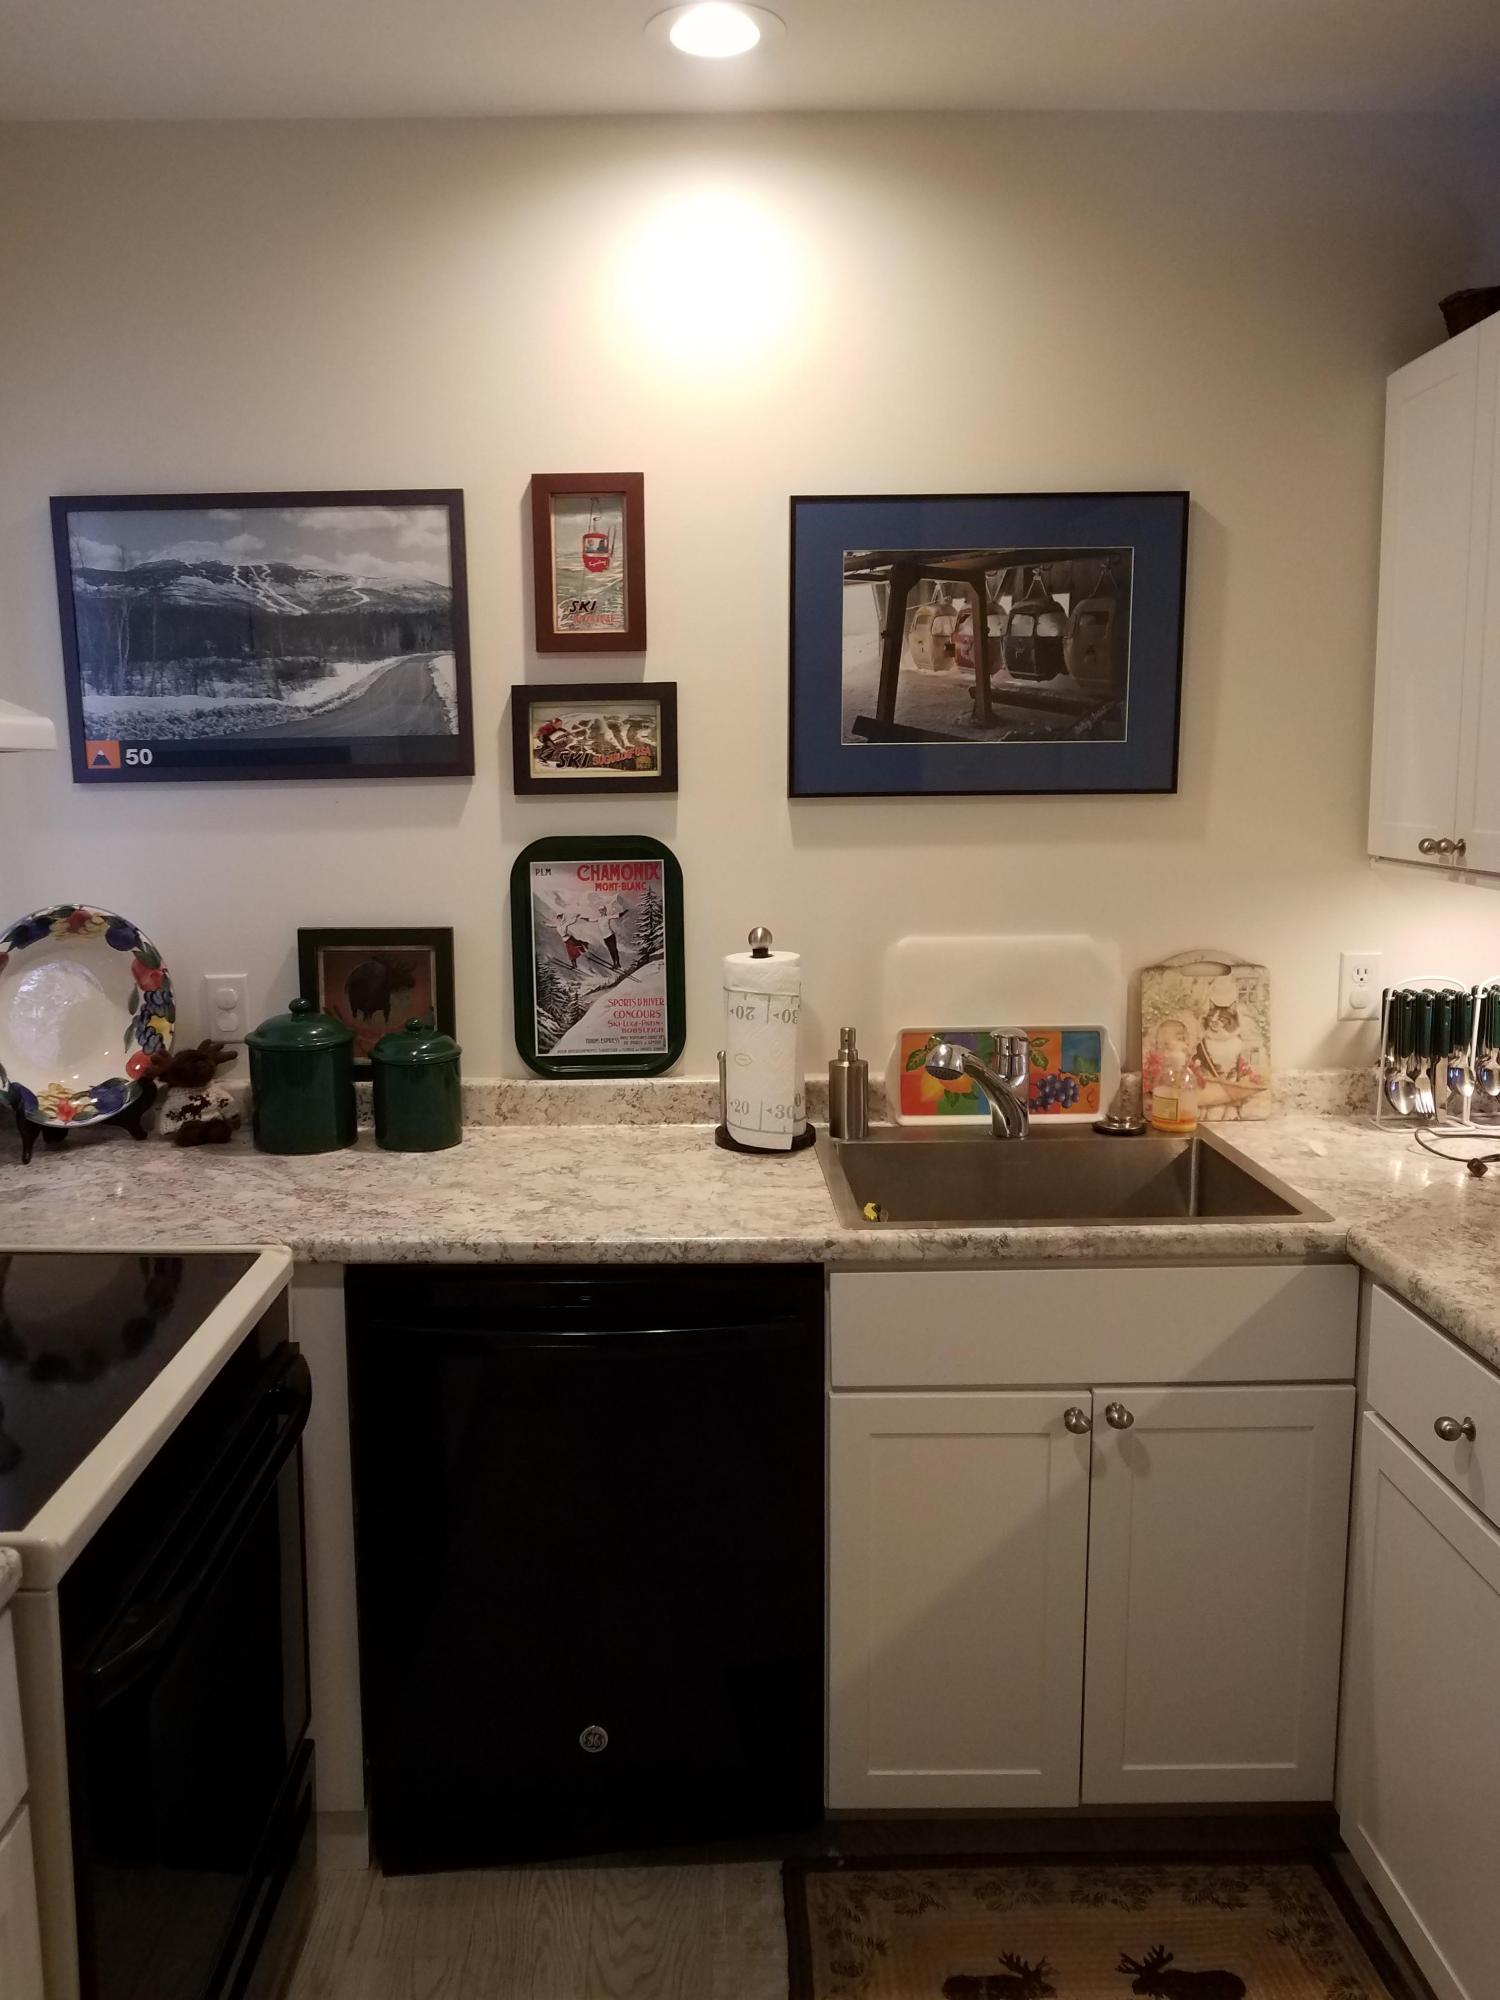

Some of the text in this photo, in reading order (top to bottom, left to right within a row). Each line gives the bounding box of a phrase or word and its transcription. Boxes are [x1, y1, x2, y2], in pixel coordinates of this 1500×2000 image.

[569, 600, 597, 613] SKI
[125, 748, 153, 766] 50
[556, 752, 591, 768] SKI
[576, 862, 661, 882] CHAMONIX
[594, 882, 647, 892] MONT-BLANC
[607, 998, 637, 1008] SPORTS
[613, 1009, 662, 1019] CONCOURS
